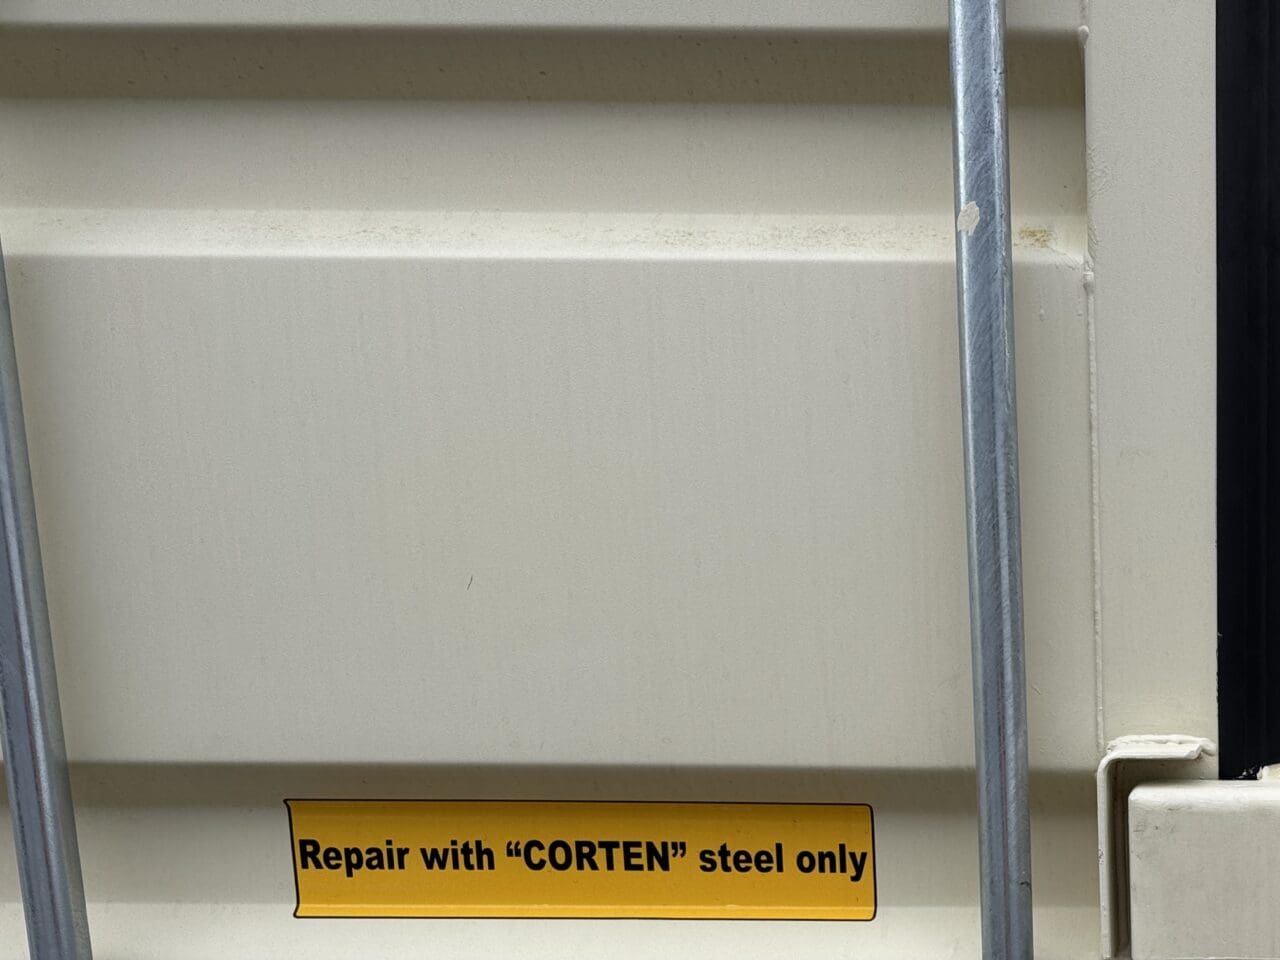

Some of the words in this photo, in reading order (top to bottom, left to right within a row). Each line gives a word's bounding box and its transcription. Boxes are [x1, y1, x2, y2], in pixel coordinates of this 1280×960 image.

[299, 838, 410, 878] Repair
[419, 839, 496, 871] with
[506, 839, 688, 872] “CORTEN”
[698, 842, 785, 874] steel
[796, 843, 868, 882] only
